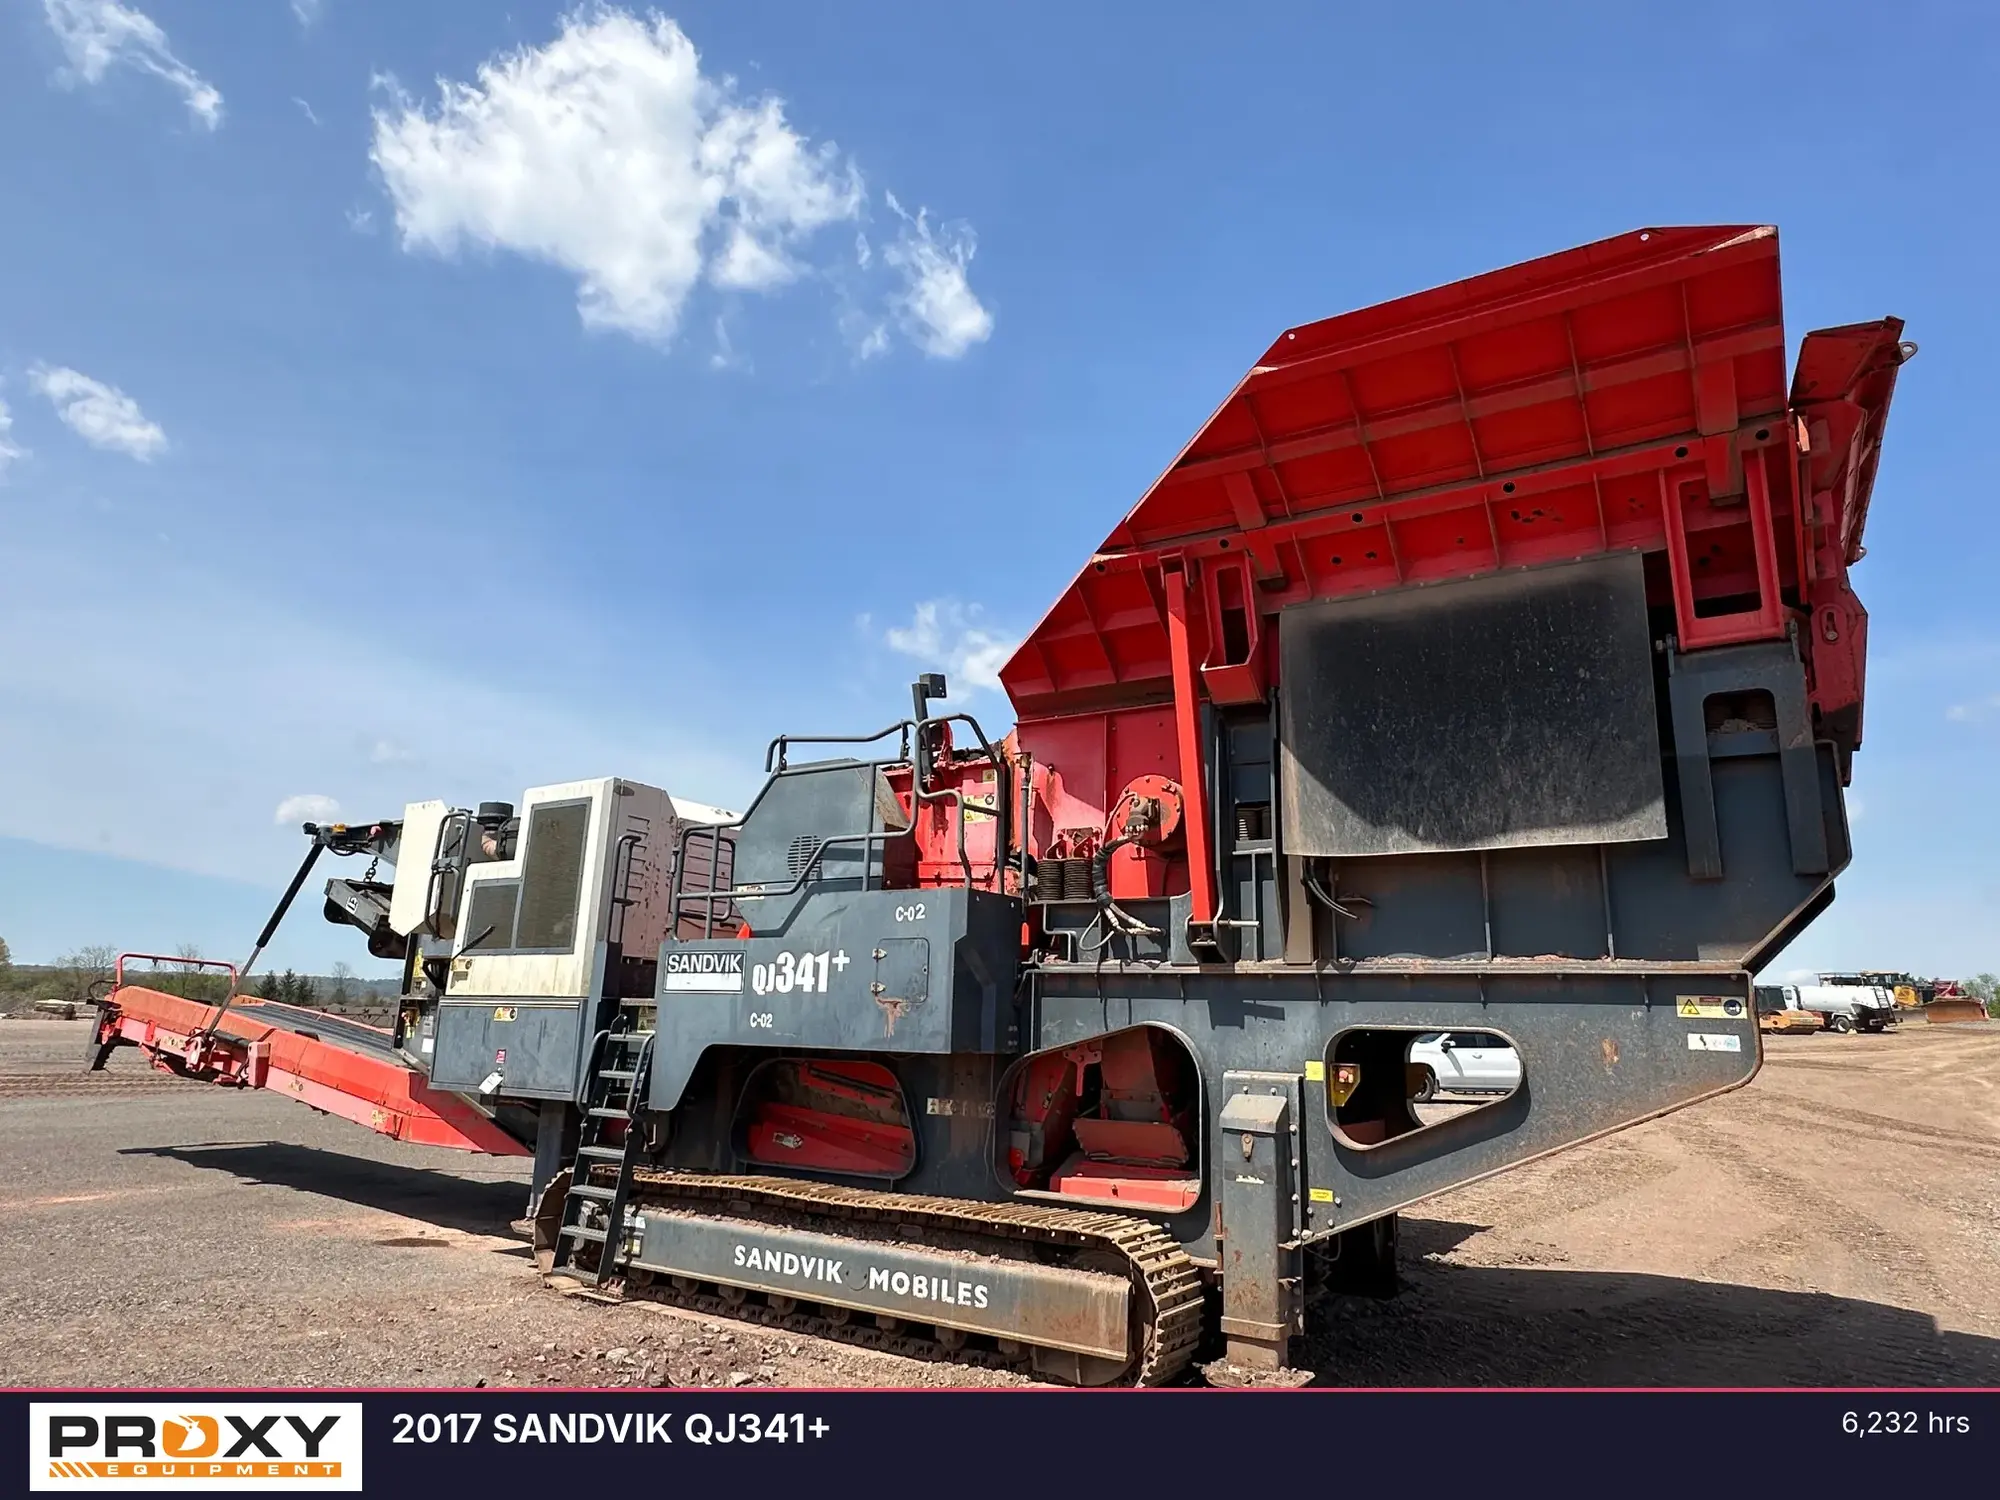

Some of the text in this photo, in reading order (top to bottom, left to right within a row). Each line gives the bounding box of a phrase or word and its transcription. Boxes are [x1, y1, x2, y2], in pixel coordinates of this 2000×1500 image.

[895, 903, 926, 922] C-02
[667, 953, 742, 973] SANDVIK
[752, 949, 850, 996] QJ341+
[750, 1012, 773, 1028] C-02
[734, 1244, 989, 1309] SANDVIK MOBILES
